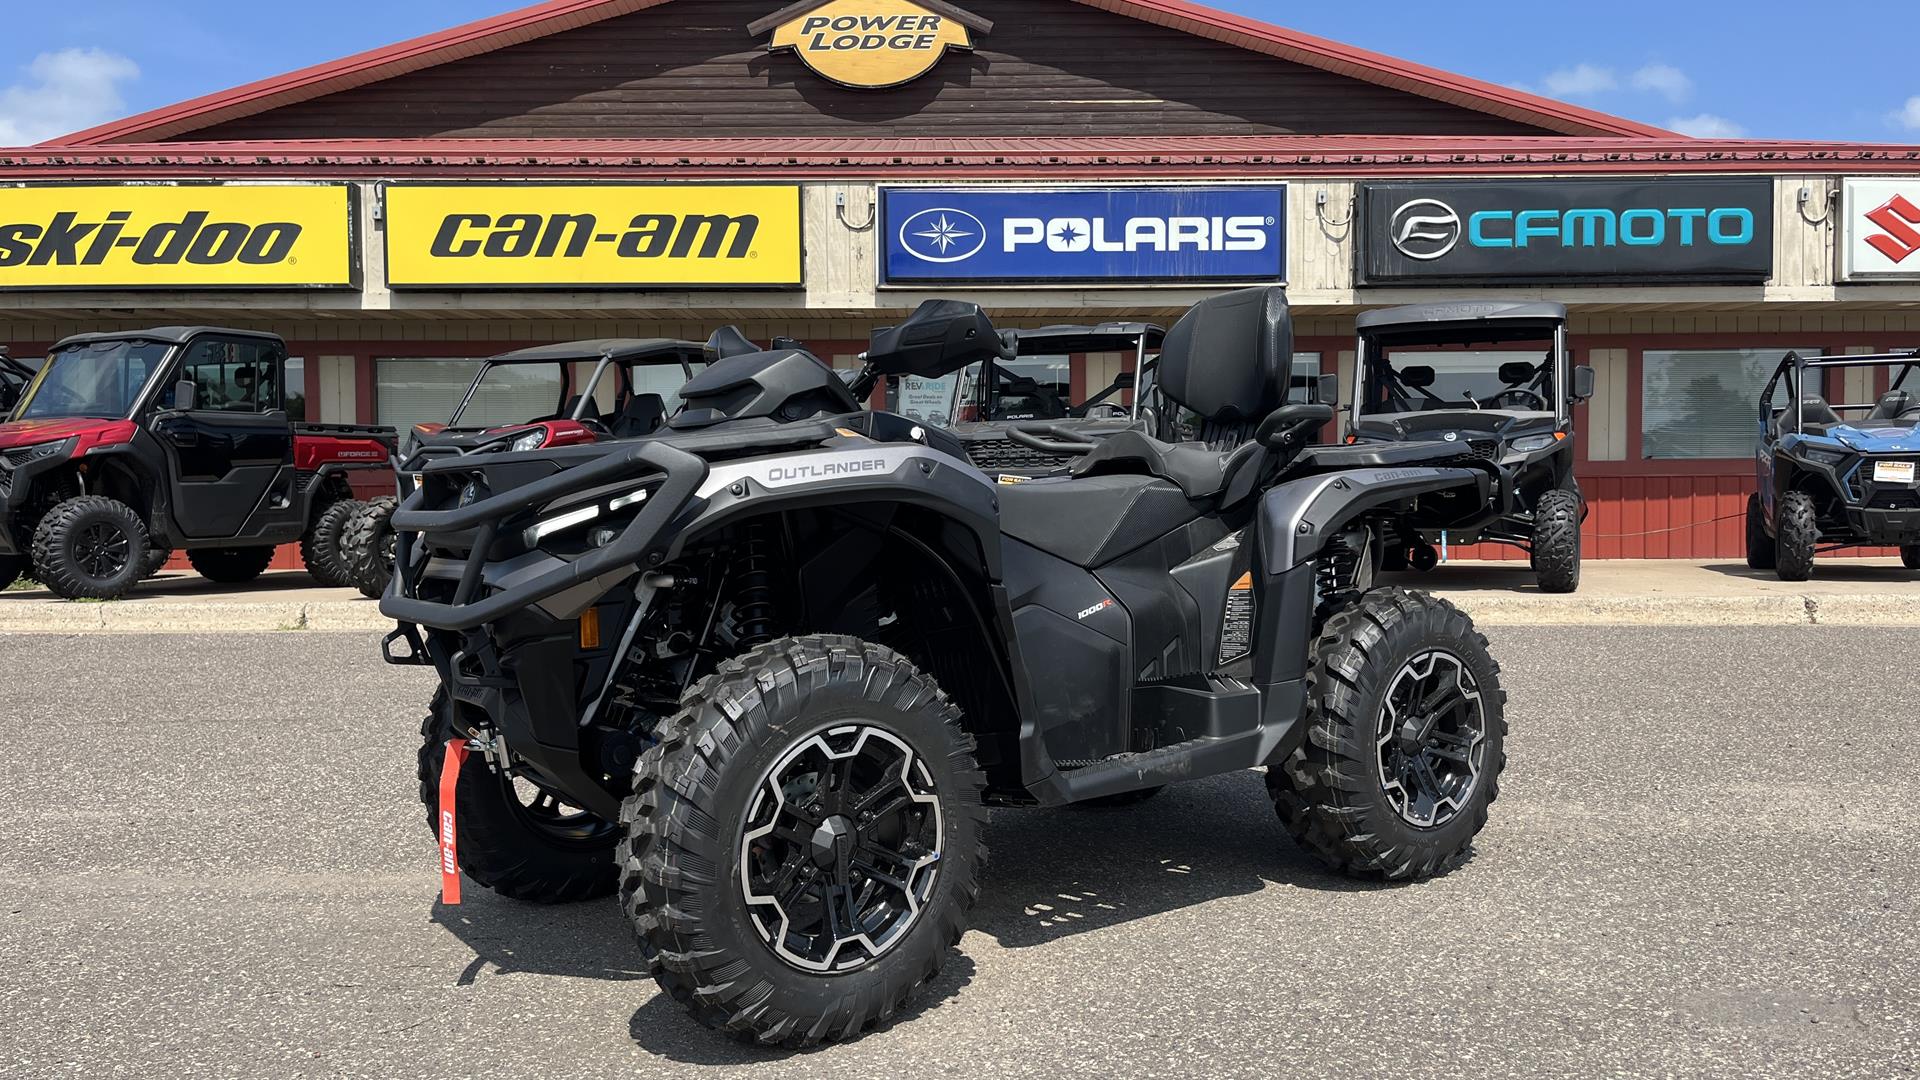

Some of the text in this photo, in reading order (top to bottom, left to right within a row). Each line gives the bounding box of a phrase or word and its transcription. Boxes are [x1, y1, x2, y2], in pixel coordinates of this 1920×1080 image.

[801, 15, 941, 35] POWER
[808, 33, 937, 51] LODGE
[0, 211, 303, 265] ski-doo
[430, 213, 760, 258] can-am
[1003, 216, 1266, 252] POLARIS
[1468, 207, 1754, 248] CFMOTO
[768, 459, 885, 481] OUTLANDER
[442, 811, 455, 875] can-am
